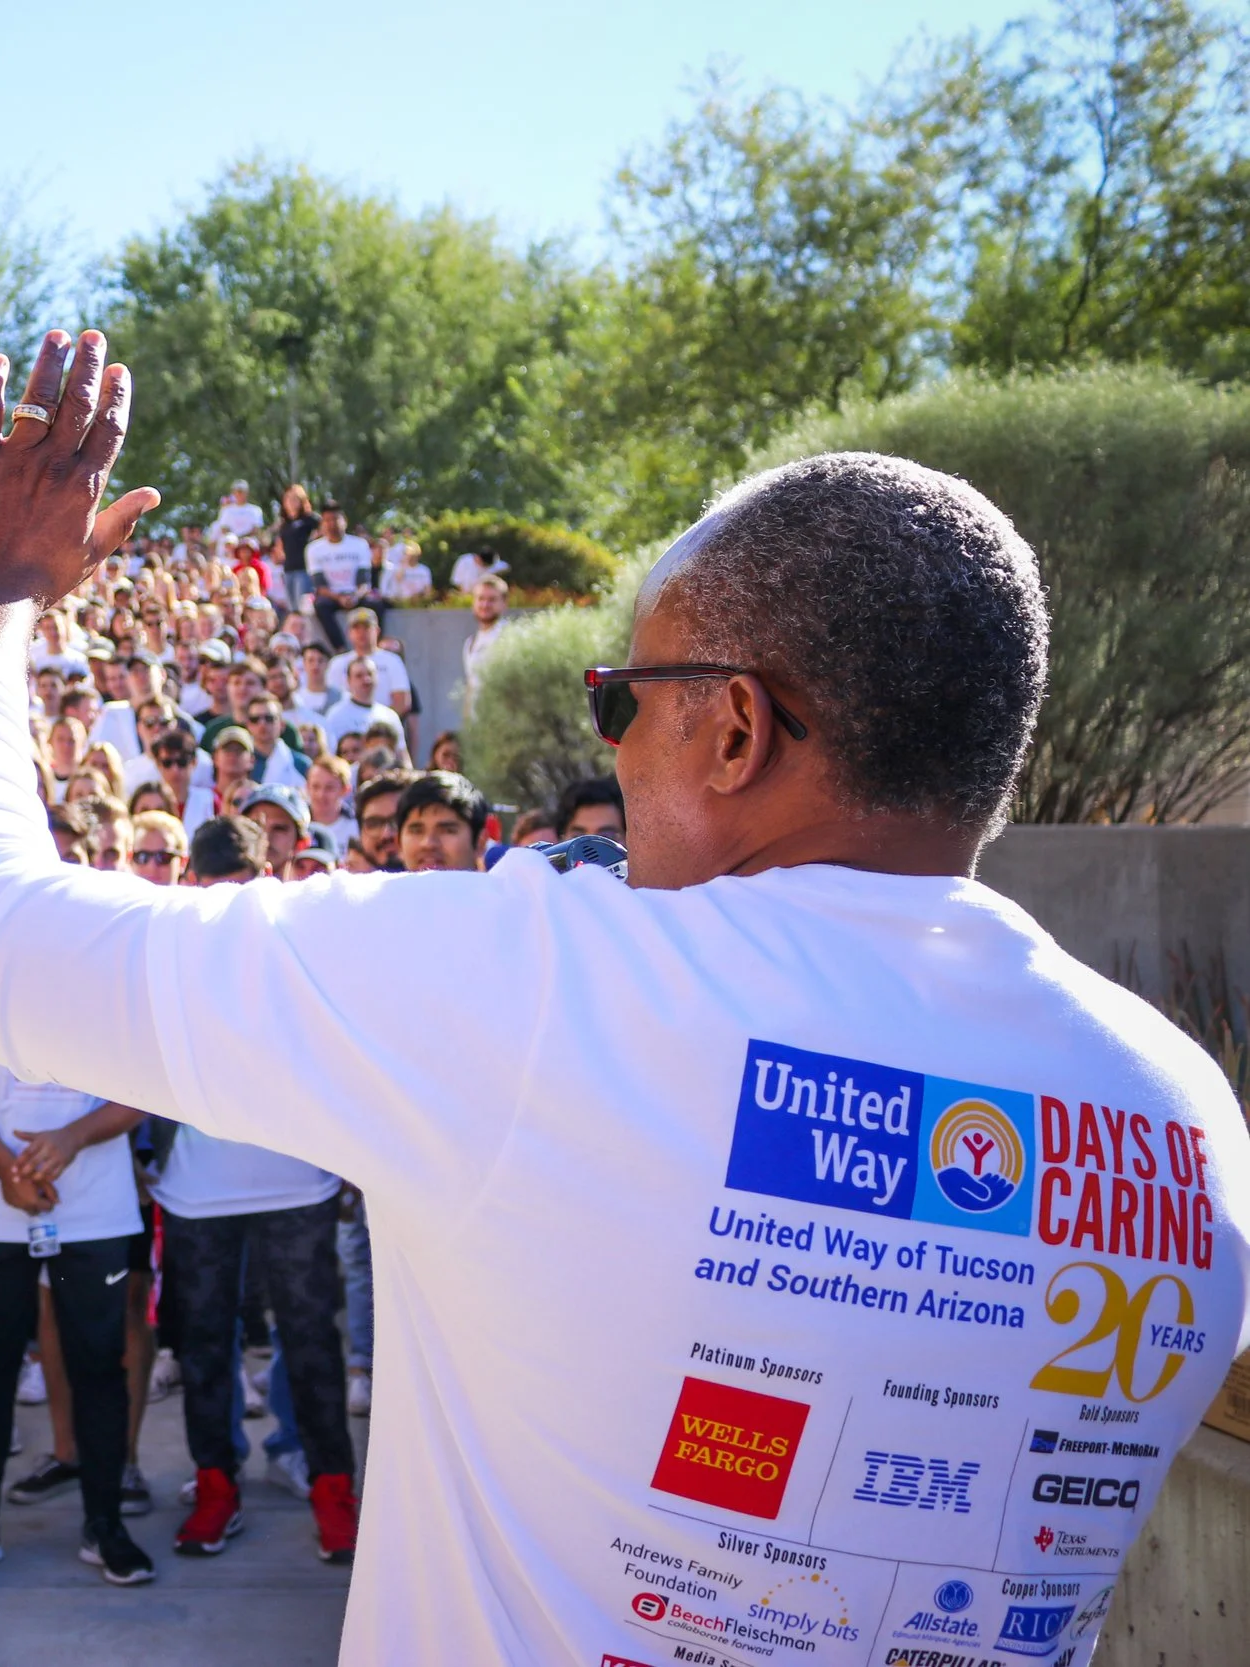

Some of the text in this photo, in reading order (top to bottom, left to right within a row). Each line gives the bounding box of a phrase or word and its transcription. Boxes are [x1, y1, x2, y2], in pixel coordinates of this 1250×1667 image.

[754, 1058, 911, 1136] United
[1040, 1094, 1208, 1190] DAYS OF
[811, 1128, 908, 1206] Way
[1038, 1166, 1213, 1270] CARING
[708, 1206, 1035, 1285] United Way of Tucson
[694, 1257, 1025, 1329] and Southern Arizona
[1029, 1261, 1194, 1403] 20
[1150, 1324, 1206, 1353] YEARS
[690, 1342, 824, 1385] Platinum Sponsors
[883, 1379, 1000, 1409] Founding Sponsors
[1079, 1404, 1140, 1425] Gold Sponsors
[681, 1413, 790, 1458] WELLS
[674, 1440, 779, 1482] FARGO
[853, 1450, 981, 1513] IBM
[1032, 1473, 1140, 1509] GEICO
[718, 1531, 828, 1571] Silver Sponsors
[1054, 1545, 1120, 1558] INSTRUMENTS
[1057, 1531, 1087, 1544] TEXAS
[610, 1537, 743, 1590] Andrews Family
[624, 1562, 718, 1601] Foundation
[1002, 1578, 1038, 1599] Copper
[1041, 1579, 1081, 1600] Sponsors
[667, 1619, 774, 1657] collaborate forward
[670, 1603, 816, 1653] BeachFleischman
[748, 1603, 859, 1642] simply bits
[903, 1612, 979, 1637] Allstate
[673, 1646, 716, 1666] Media
